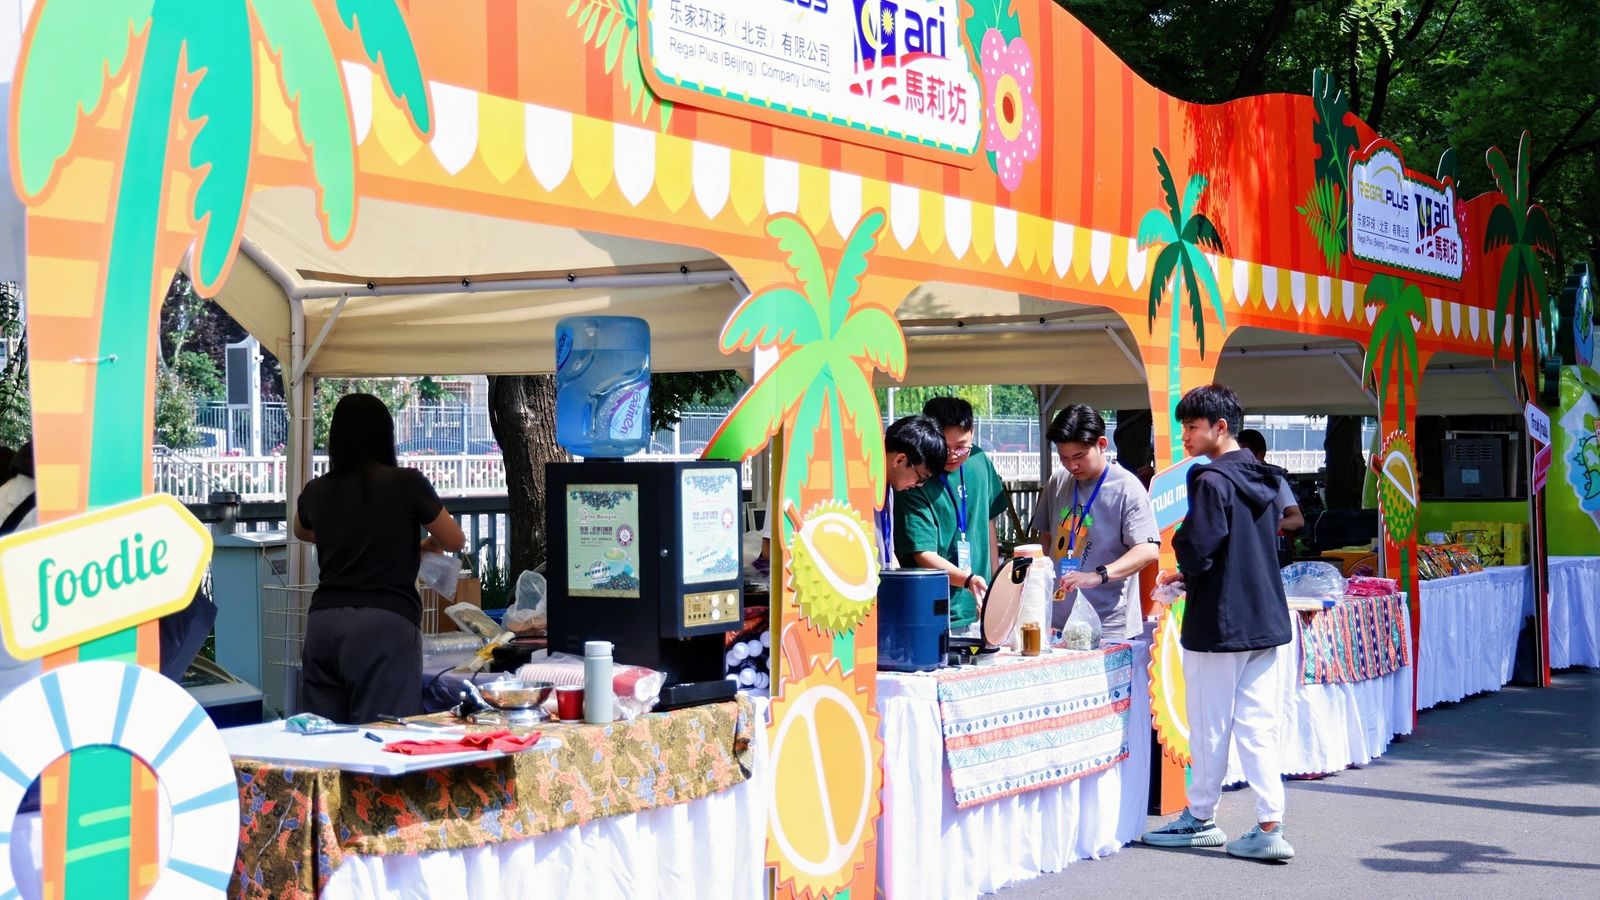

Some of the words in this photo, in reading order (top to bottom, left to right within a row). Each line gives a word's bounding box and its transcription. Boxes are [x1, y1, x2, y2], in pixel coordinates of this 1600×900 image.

[669, 37, 696, 59] Regal
[699, 45, 719, 64] Plus
[721, 51, 757, 76] (Beijing)
[761, 62, 800, 88] Company
[802, 74, 830, 93] Limited
[905, 68, 967, 125] 馬莉坊
[1434, 235, 1458, 265] 馬莉坊
[1151, 489, 1175, 512] rasa
[32, 532, 169, 632] foodie
